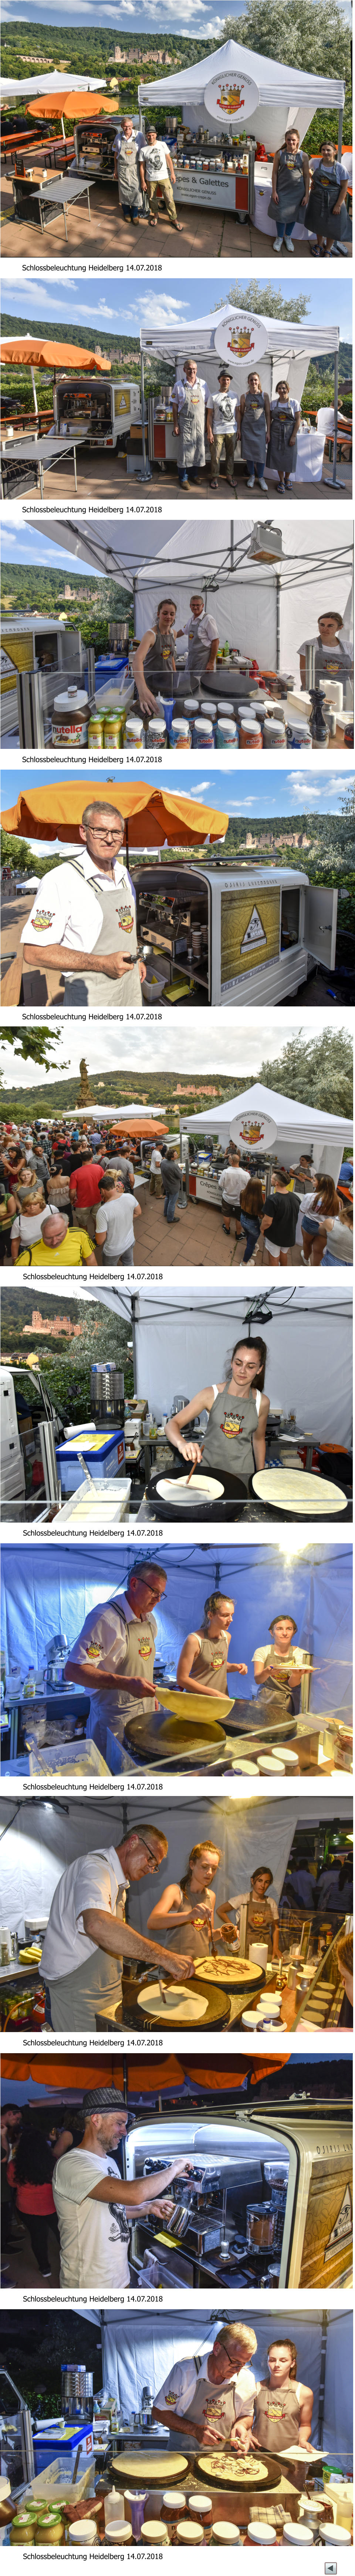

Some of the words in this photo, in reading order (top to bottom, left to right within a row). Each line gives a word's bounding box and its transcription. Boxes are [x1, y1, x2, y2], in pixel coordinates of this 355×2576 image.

[211, 73, 237, 85] KÖNIGLICHER
[237, 74, 252, 85] GENUSS
[199, 178, 229, 187] Galettes
[222, 316, 247, 327] KÖNIGLICHER
[247, 317, 261, 329] GENUSS
[53, 725, 82, 734] nutella
[236, 1112, 258, 1121] KÖNIGLICHER
[258, 1113, 271, 1123] GENUSS
[200, 1181, 217, 1189] Crêpes
[317, 2145, 339, 2154] OSIRIS
